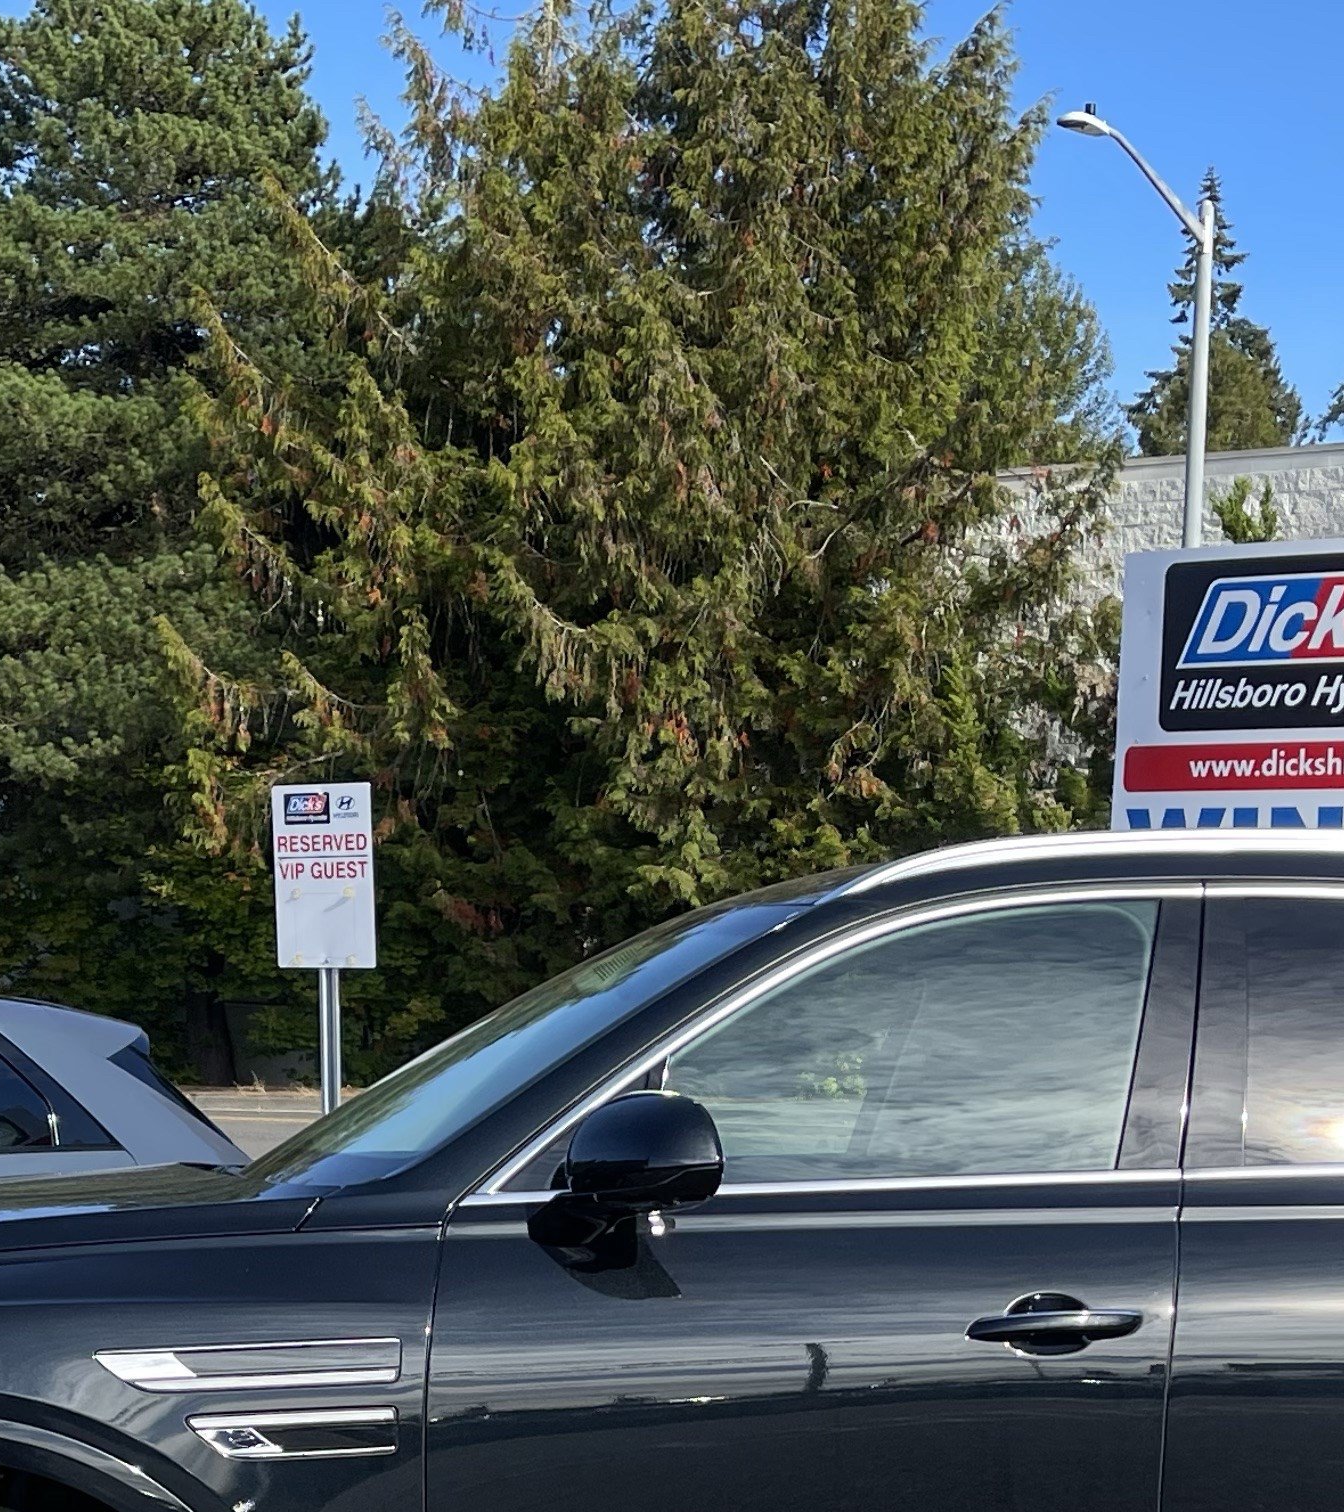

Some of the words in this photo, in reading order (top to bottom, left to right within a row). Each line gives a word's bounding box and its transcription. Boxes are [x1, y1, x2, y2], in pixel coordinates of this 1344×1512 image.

[1168, 677, 1307, 711] Hillsboro
[277, 833, 367, 853] RESERVED
[279, 861, 305, 880] VIP
[311, 860, 368, 880] GUEST
